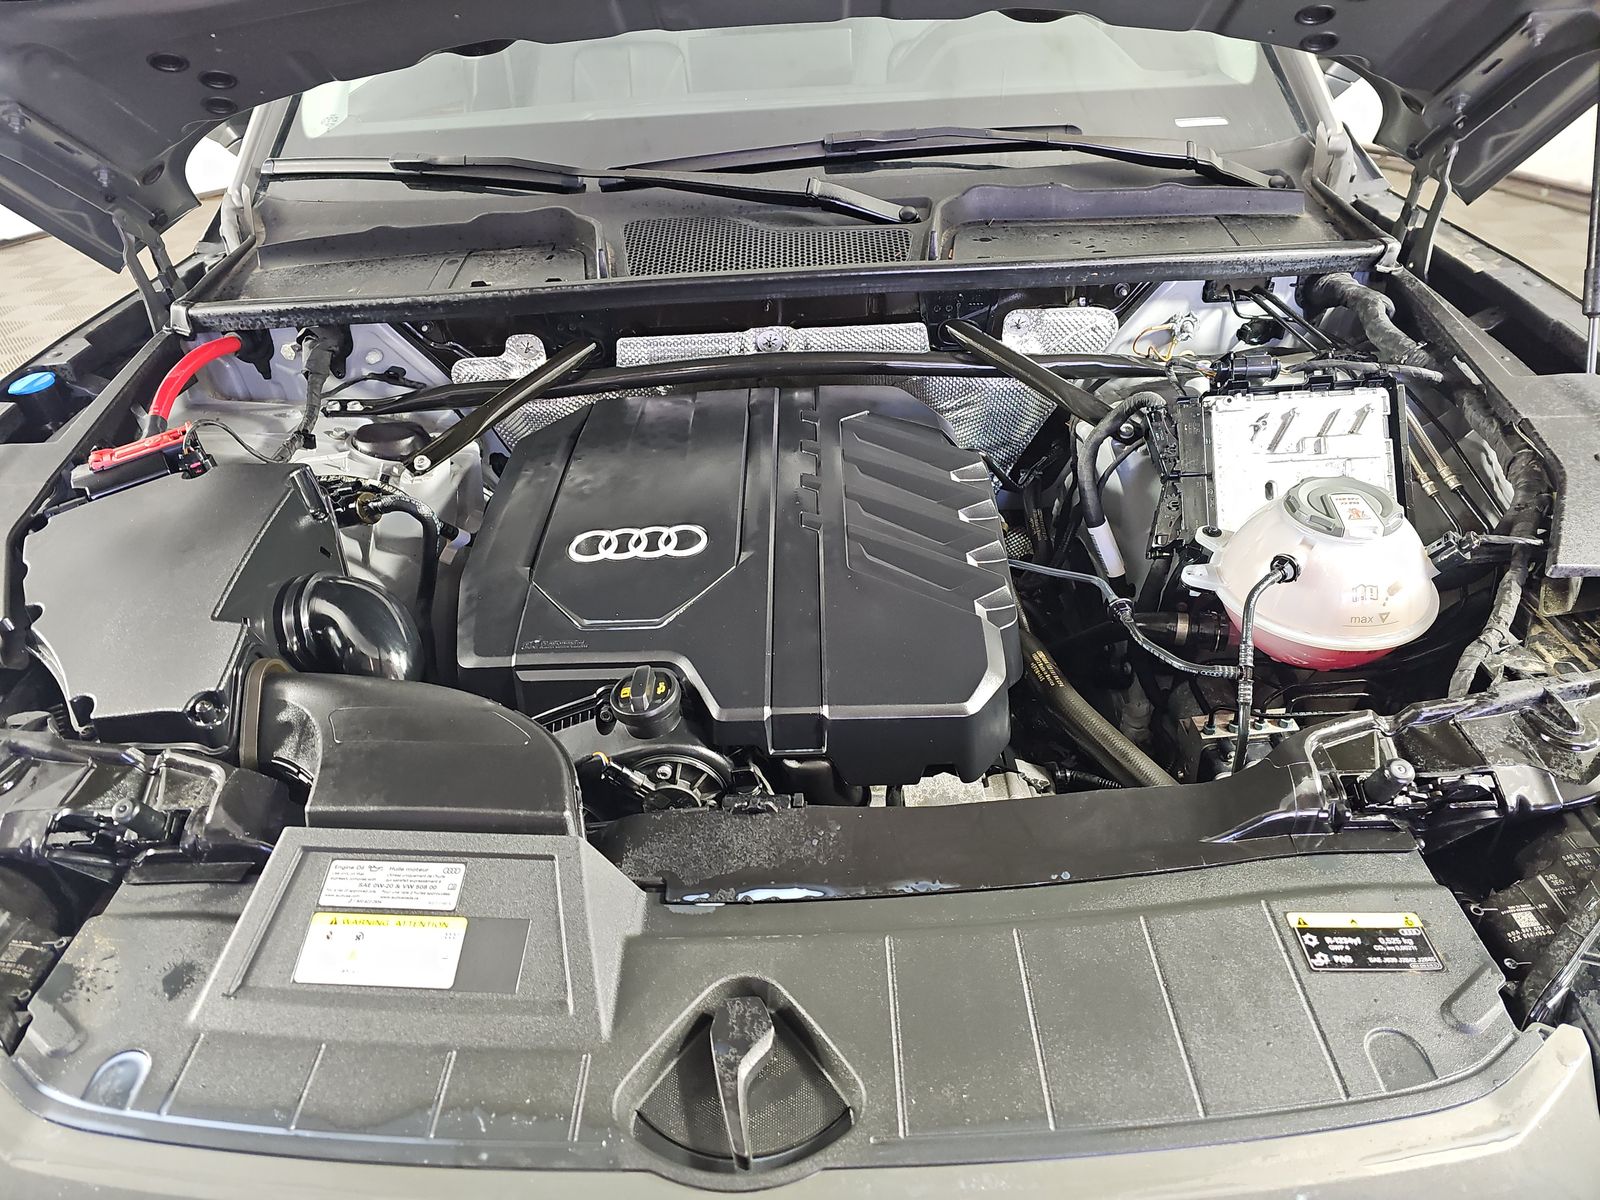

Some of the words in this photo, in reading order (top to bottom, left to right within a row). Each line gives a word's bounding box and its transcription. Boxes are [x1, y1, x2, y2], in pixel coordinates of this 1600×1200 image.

[1350, 615, 1374, 624] max
[334, 864, 355, 872] Engine
[342, 918, 389, 927] WARNING
[395, 919, 449, 928] ATTENTION
[1401, 937, 1414, 946] kg
